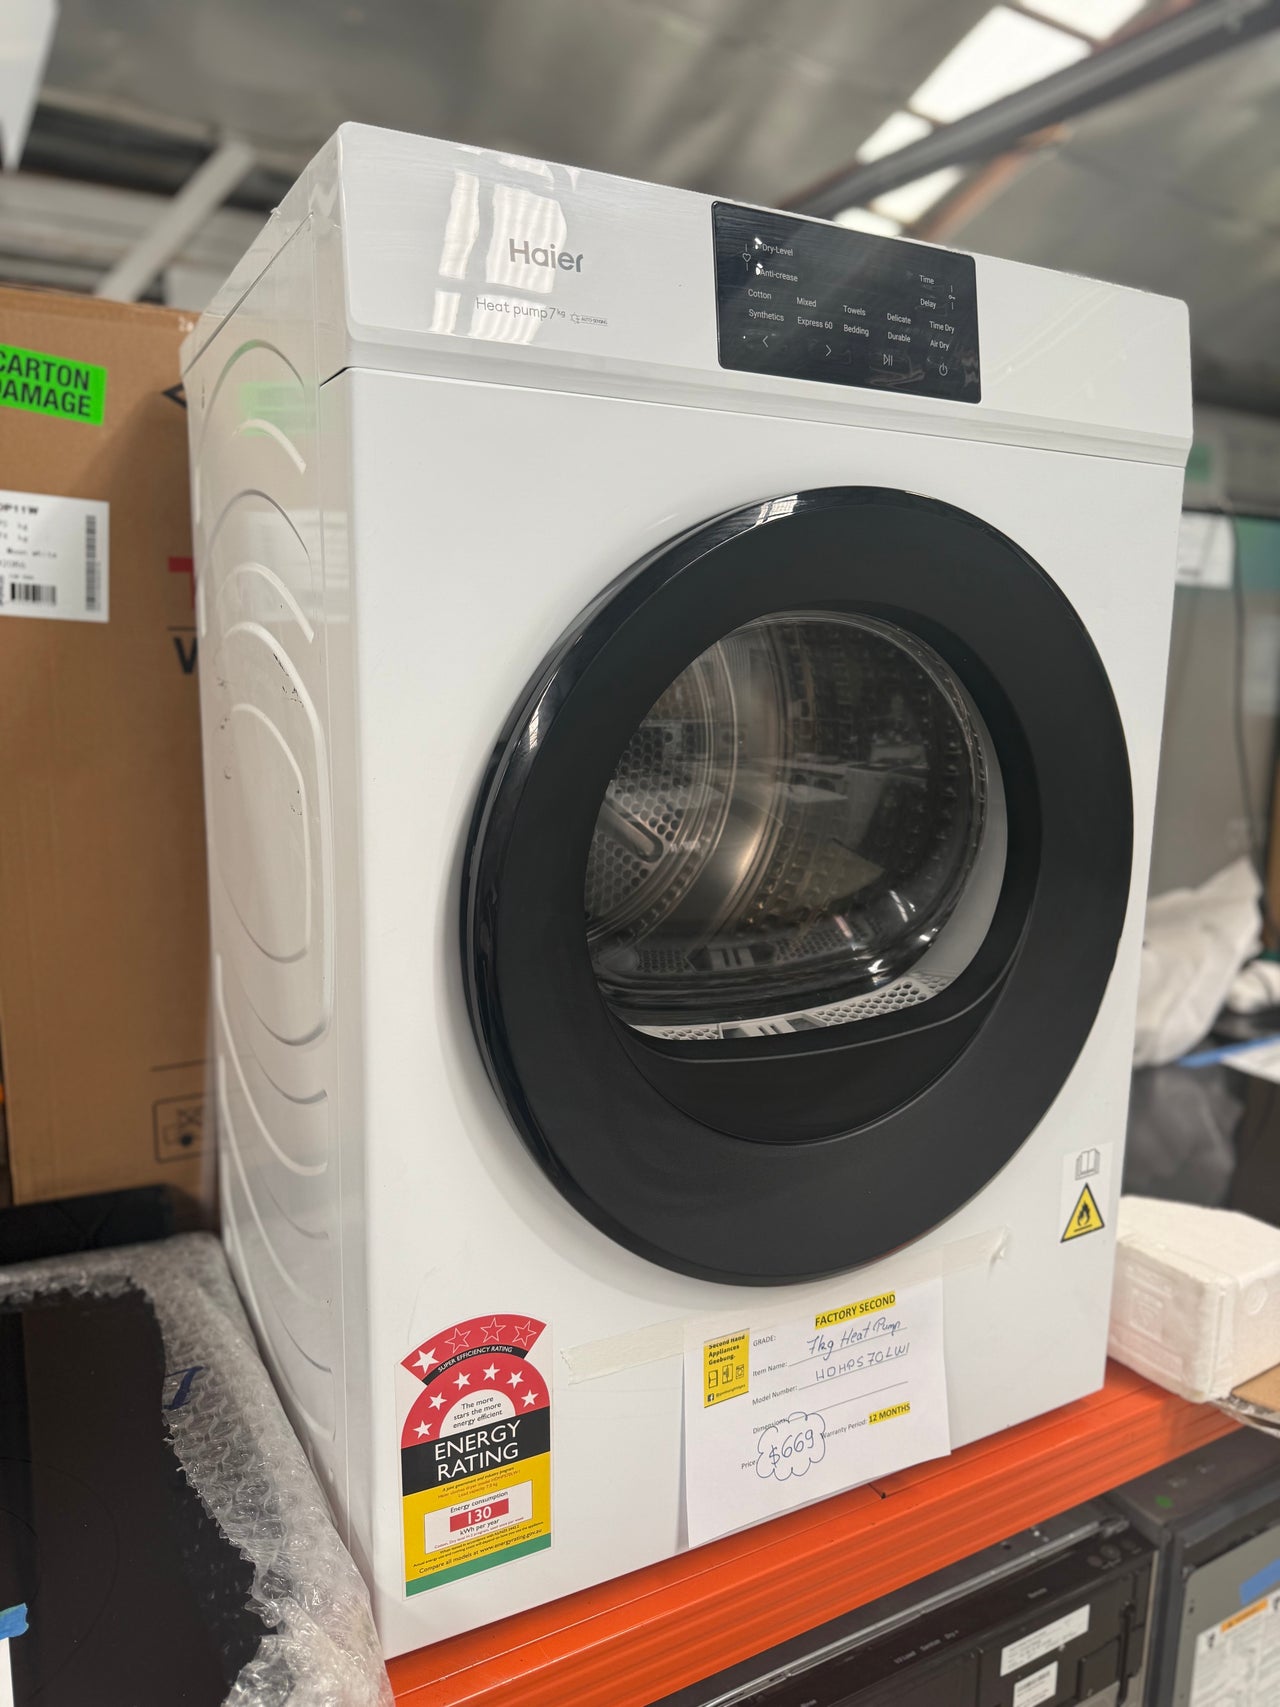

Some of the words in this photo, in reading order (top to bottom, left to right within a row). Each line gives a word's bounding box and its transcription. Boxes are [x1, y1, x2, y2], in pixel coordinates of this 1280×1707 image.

[509, 238, 584, 273] Haier
[762, 243, 794, 257] Dry-Level
[760, 268, 799, 282] Anti-crease
[920, 274, 935, 285] Time
[748, 289, 772, 300] Cotton
[796, 297, 817, 308] Mixed
[476, 297, 510, 314] Heat
[513, 303, 548, 321] pump
[843, 304, 866, 316] Towels
[920, 298, 937, 309] Delay
[748, 309, 785, 322] Synthetics
[797, 316, 823, 328] Express
[824, 321, 833, 330] 60
[886, 312, 912, 325] Delicate
[843, 324, 870, 338] Bedding
[929, 320, 944, 332] Time
[945, 323, 955, 334] Dry
[887, 331, 911, 343] Durable
[930, 339, 939, 348] Air
[939, 341, 950, 352] Dry
[0, 378, 92, 418] AMAGE
[752, 1334, 777, 1347] GRADE:
[814, 1305, 857, 1328] FACTORY
[859, 1293, 896, 1314] SECOND
[807, 1334, 834, 1361] 7kg
[839, 1320, 871, 1348] Heat
[872, 1316, 901, 1337] Pump
[437, 1358, 456, 1373] SUPER
[456, 1346, 491, 1361] EFFICIENCY
[490, 1345, 513, 1353] RATING
[708, 1344, 740, 1358] Appliances
[752, 1368, 767, 1377] Item
[767, 1361, 788, 1372] Name:
[461, 1402, 475, 1410] The
[476, 1396, 494, 1406] more
[752, 1393, 771, 1406] Model
[771, 1385, 798, 1399] Number:
[453, 1411, 470, 1421] stars
[471, 1408, 483, 1416] the
[483, 1402, 502, 1412] more
[453, 1418, 476, 1429] energy
[476, 1410, 503, 1422] efficient
[868, 1414, 878, 1423] 12
[878, 1403, 911, 1420] MONTHS
[434, 1419, 521, 1461] ENERGY
[768, 1428, 815, 1469] $669
[437, 1442, 519, 1482] RATING
[450, 1503, 471, 1514] Energy
[471, 1491, 509, 1507] consumption
[468, 1506, 492, 1525] 130
[460, 1526, 475, 1535] kWh
[475, 1523, 486, 1532] per
[487, 1518, 500, 1528] year
[419, 1561, 445, 1574] Compare
[452, 1552, 473, 1563] models
